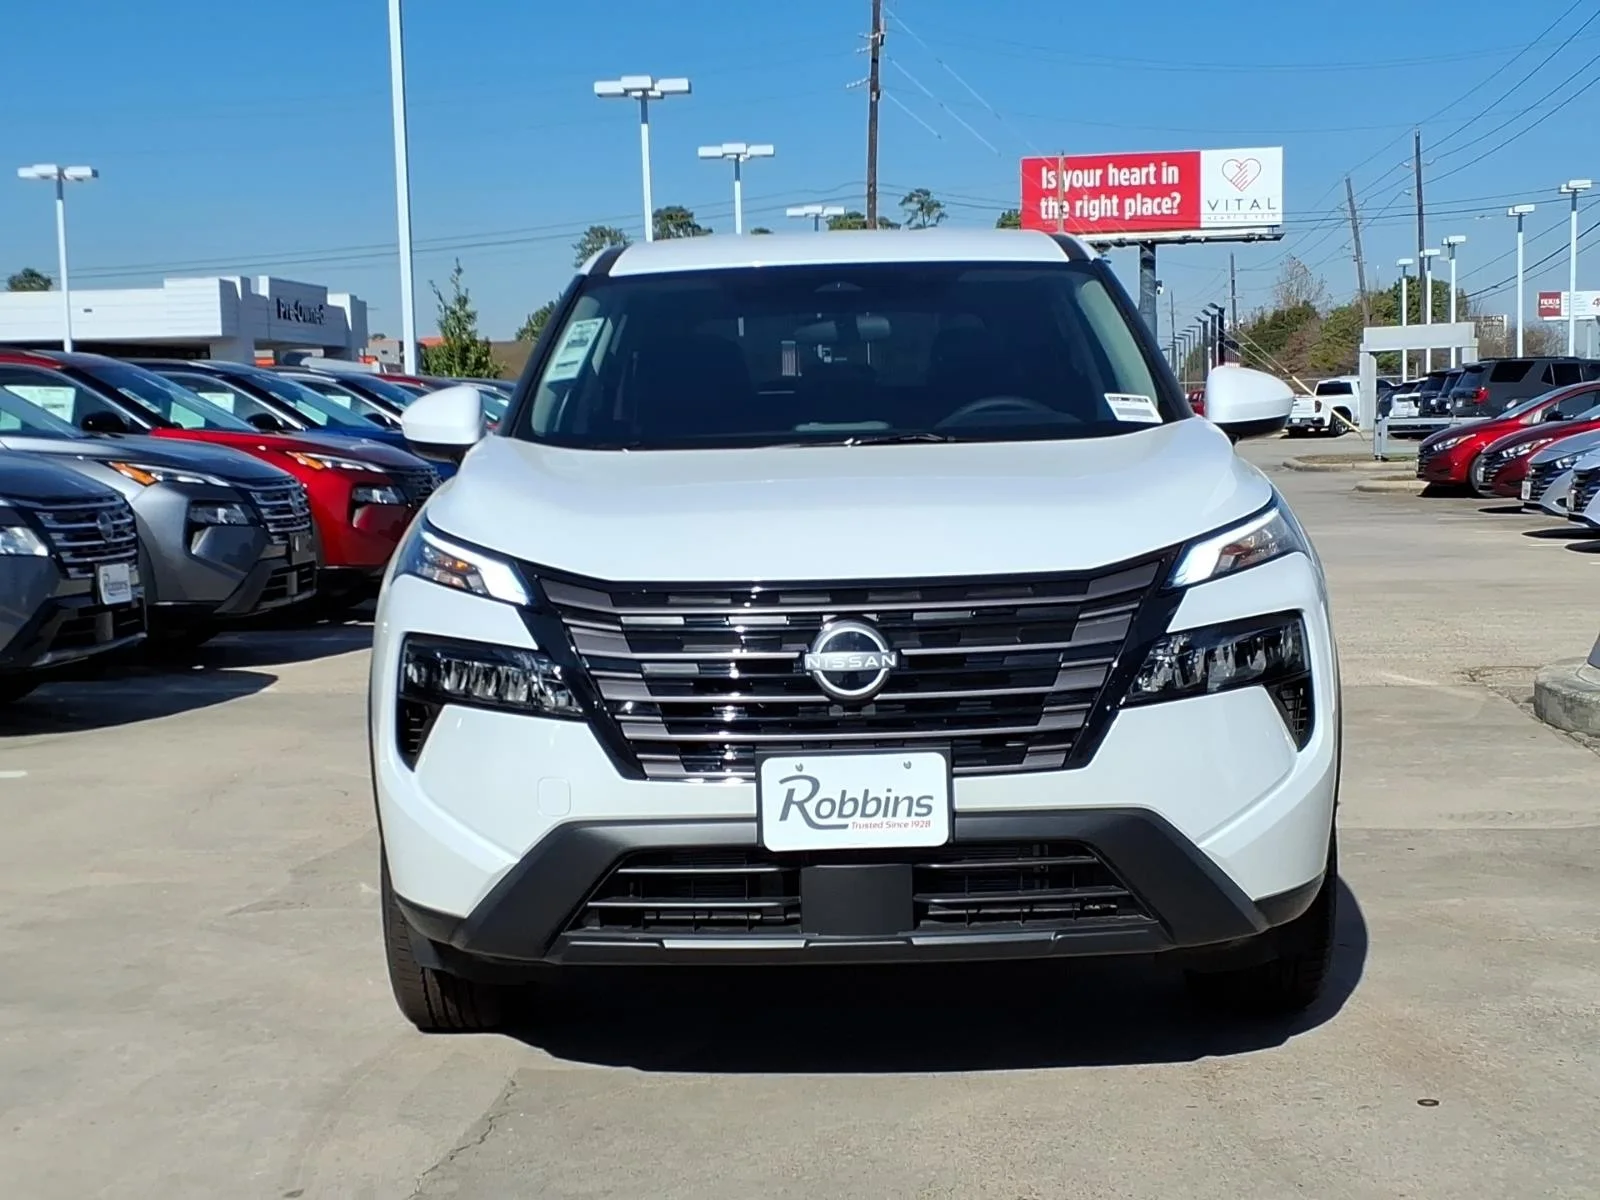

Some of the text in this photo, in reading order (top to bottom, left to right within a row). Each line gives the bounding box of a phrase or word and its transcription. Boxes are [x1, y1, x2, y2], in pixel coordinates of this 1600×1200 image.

[1041, 162, 1179, 193] Is your heart in
[1040, 192, 1181, 221] the right place?
[1207, 197, 1277, 212] VITAL
[806, 653, 896, 669] NISSAN
[778, 774, 934, 831] Robbins
[851, 820, 931, 830] Trusted Since 1928
